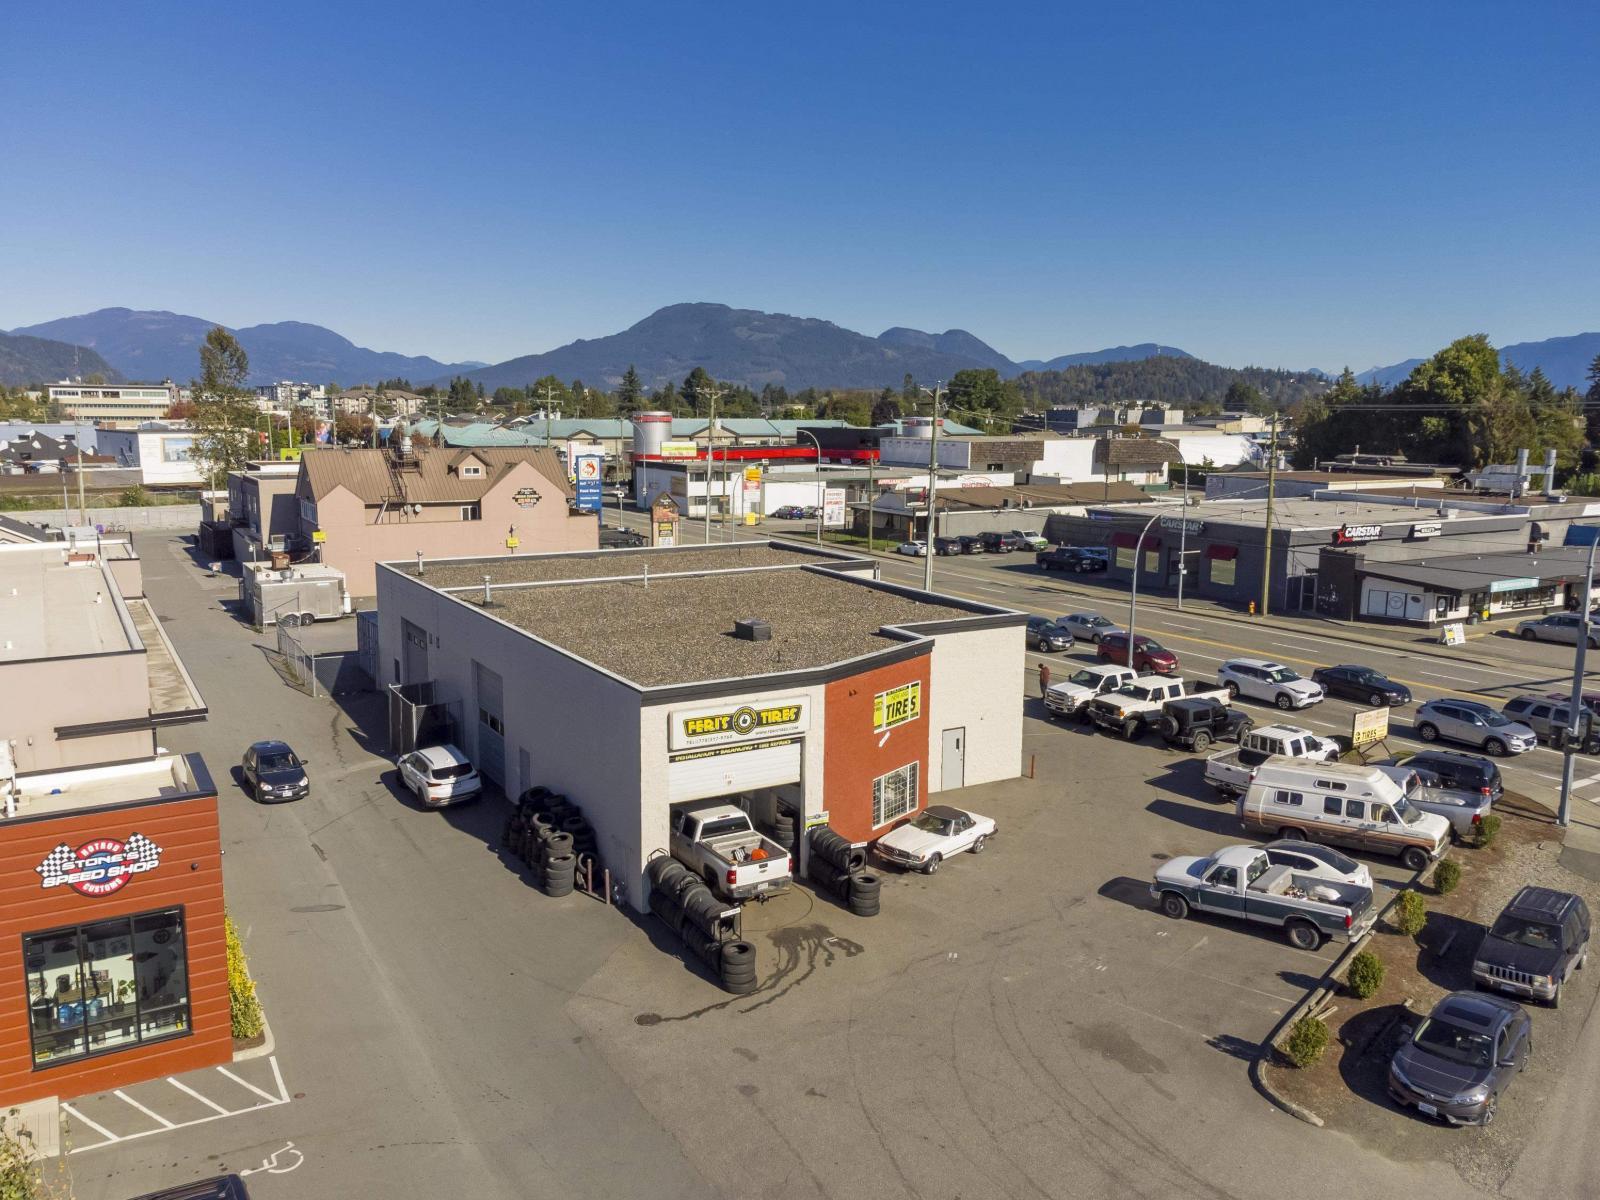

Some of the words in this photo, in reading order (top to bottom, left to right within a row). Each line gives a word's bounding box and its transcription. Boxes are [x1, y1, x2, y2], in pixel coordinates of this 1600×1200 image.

[1345, 526, 1381, 538] CARSTAR
[886, 695, 916, 721] TIRES
[687, 715, 730, 734] FERI'S
[760, 706, 798, 724] TIRES
[1362, 728, 1377, 740] TIRES
[81, 842, 120, 857] HOTROD
[62, 851, 140, 871] STONE'S
[42, 868, 106, 888] SPEED
[107, 860, 160, 877] SHOP
[82, 878, 123, 893] CUSTOMS
